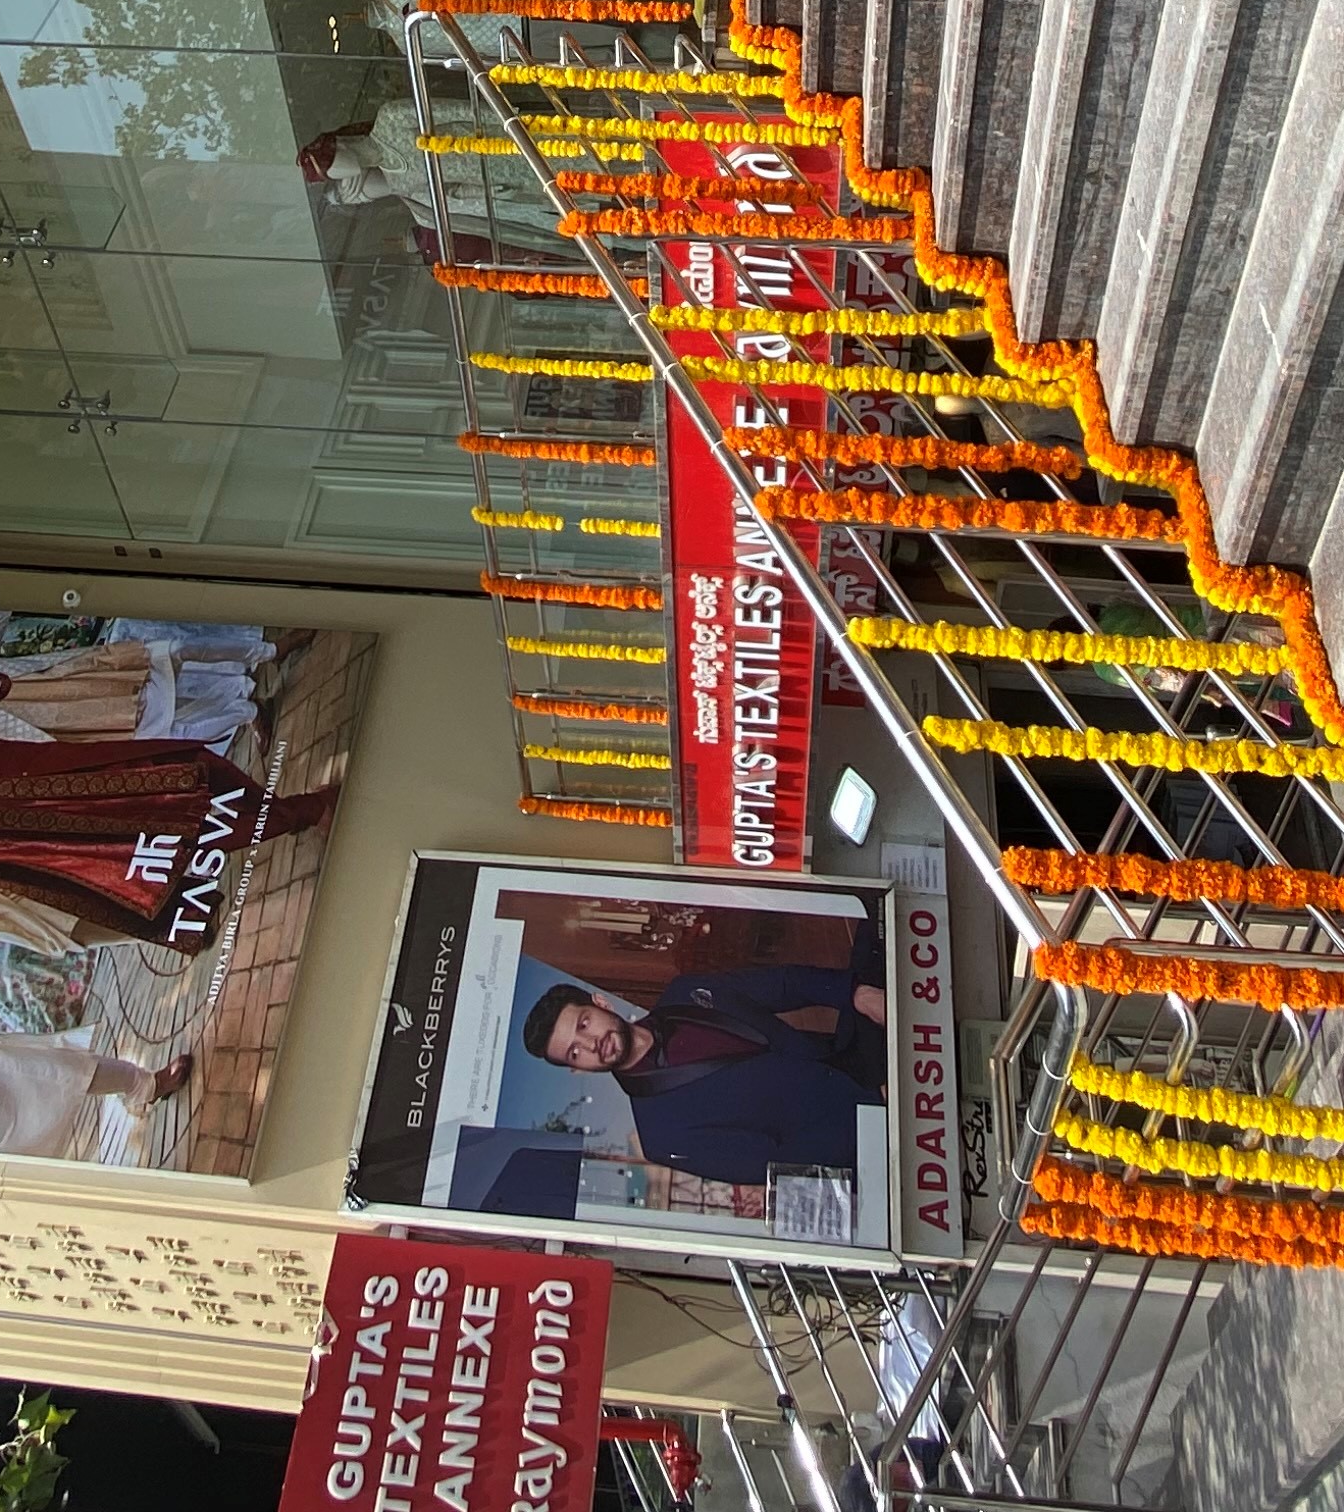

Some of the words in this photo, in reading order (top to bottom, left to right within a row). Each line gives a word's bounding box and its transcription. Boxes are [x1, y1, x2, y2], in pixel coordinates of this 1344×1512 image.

[733, 582, 783, 742] TEXTILES
[168, 787, 246, 942] TASVA
[207, 954, 228, 1005] ADITYA
[222, 909, 242, 949] BIRLA
[234, 860, 254, 906] GROUP
[250, 804, 270, 845] TARUN
[262, 740, 288, 800] TAHILIANI
[732, 752, 778, 866] GUPTA'S
[406, 925, 456, 1128] BLACKBERRYS
[913, 1024, 950, 1233] ADARSH
[326, 1275, 400, 1500] GUPTA'S
[373, 1266, 449, 1512] TEXTILES
[433, 1284, 500, 1512] ANNEXE
